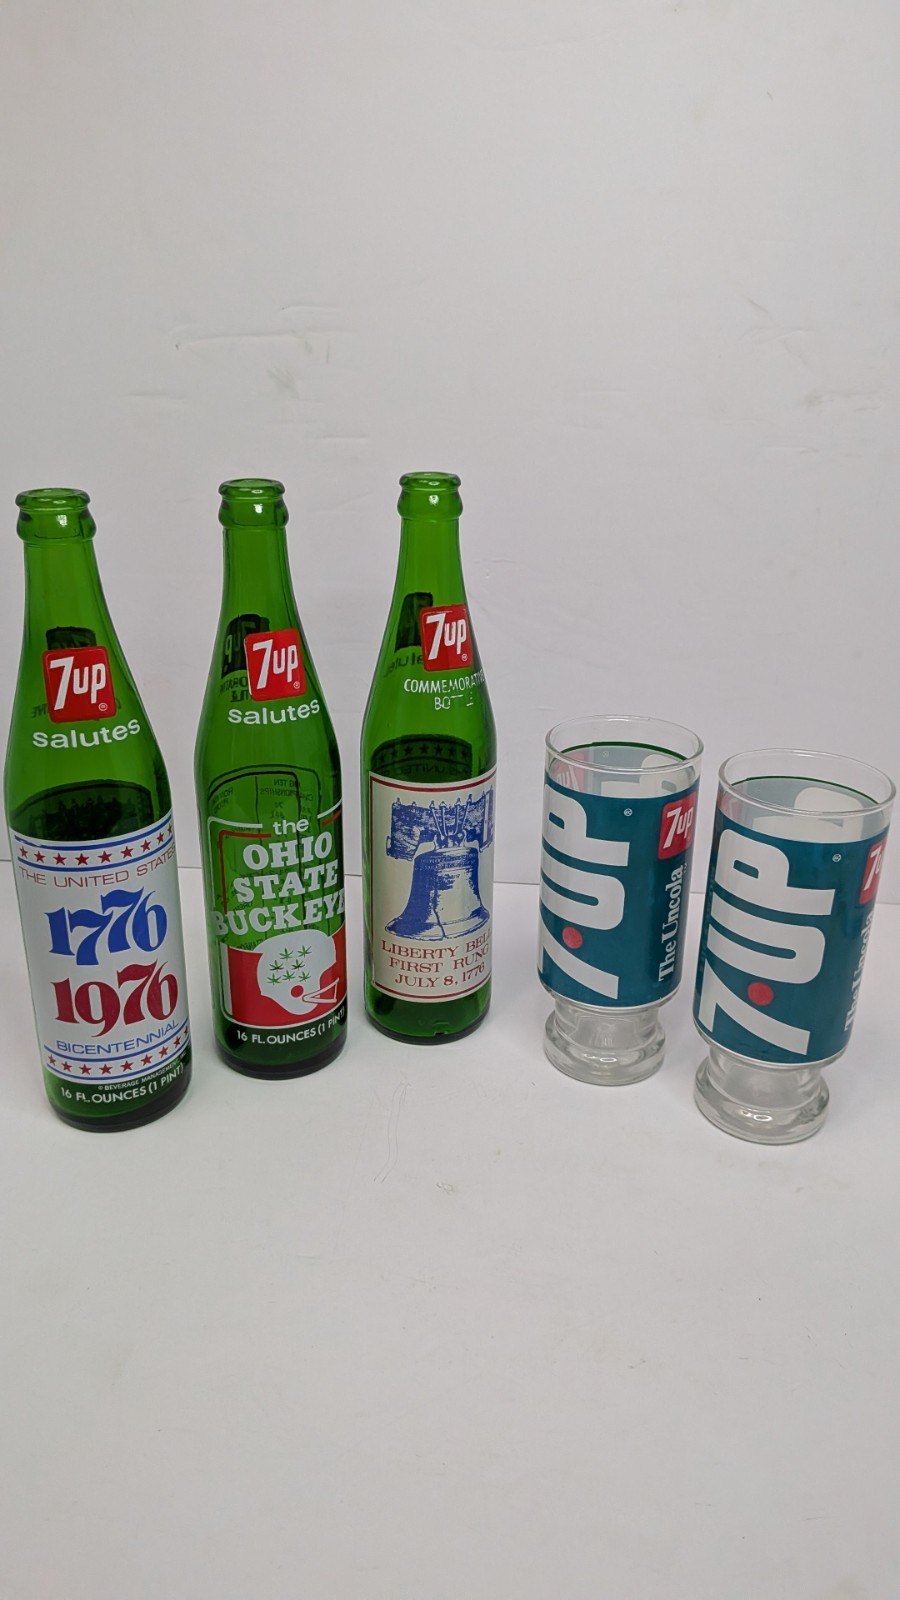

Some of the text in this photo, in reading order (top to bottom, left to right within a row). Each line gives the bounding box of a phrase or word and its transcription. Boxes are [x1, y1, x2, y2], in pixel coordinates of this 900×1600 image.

[425, 612, 467, 661] 7up
[252, 639, 299, 690] 7up
[49, 656, 106, 711] 7up
[227, 699, 320, 725] salutes
[32, 718, 140, 749] salutes
[272, 817, 309, 836] the
[663, 806, 694, 849] 7up
[243, 831, 333, 871] OHIO
[863, 845, 884, 891] 7u
[18, 865, 48, 886] THE
[53, 869, 130, 888] UNITED
[233, 858, 339, 903] STATE
[44, 886, 168, 966] 1776
[658, 863, 684, 982] The Uncola
[381, 939, 460, 959] LIBERTY
[389, 943, 489, 974] FIRST RUNG
[395, 962, 486, 988] JULY 8, 1776
[50, 958, 179, 1038] 1976
[56, 1020, 180, 1056] BICENTENNIAL
[236, 1030, 248, 1041] 16
[266, 1027, 316, 1045] OUNCES
[61, 1087, 72, 1099] 16
[91, 1086, 147, 1104] OUNCES
[104, 1079, 140, 1092] BEVERAGE
